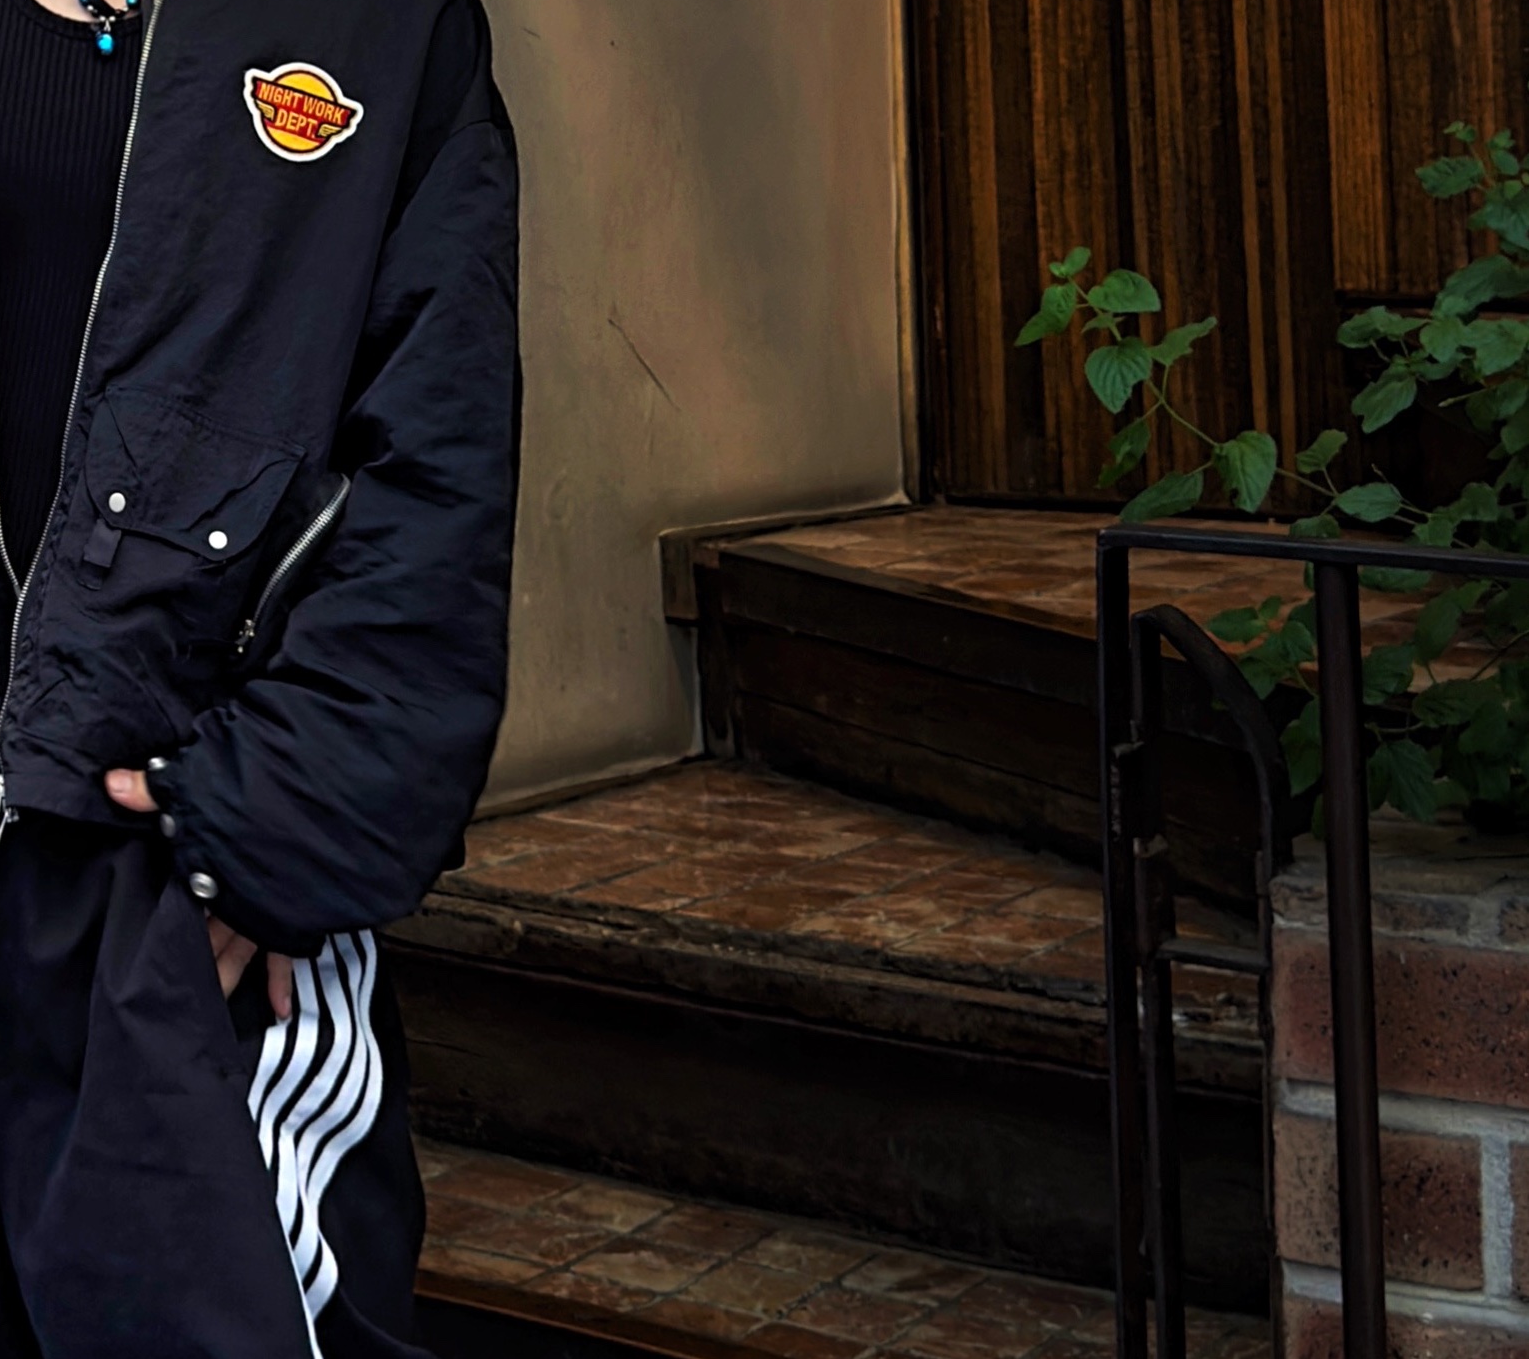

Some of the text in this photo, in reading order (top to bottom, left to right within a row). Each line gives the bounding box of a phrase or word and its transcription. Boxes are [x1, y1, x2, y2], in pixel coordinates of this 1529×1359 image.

[259, 83, 345, 124] NIGHT WORK
[276, 109, 318, 138] DEPT.
